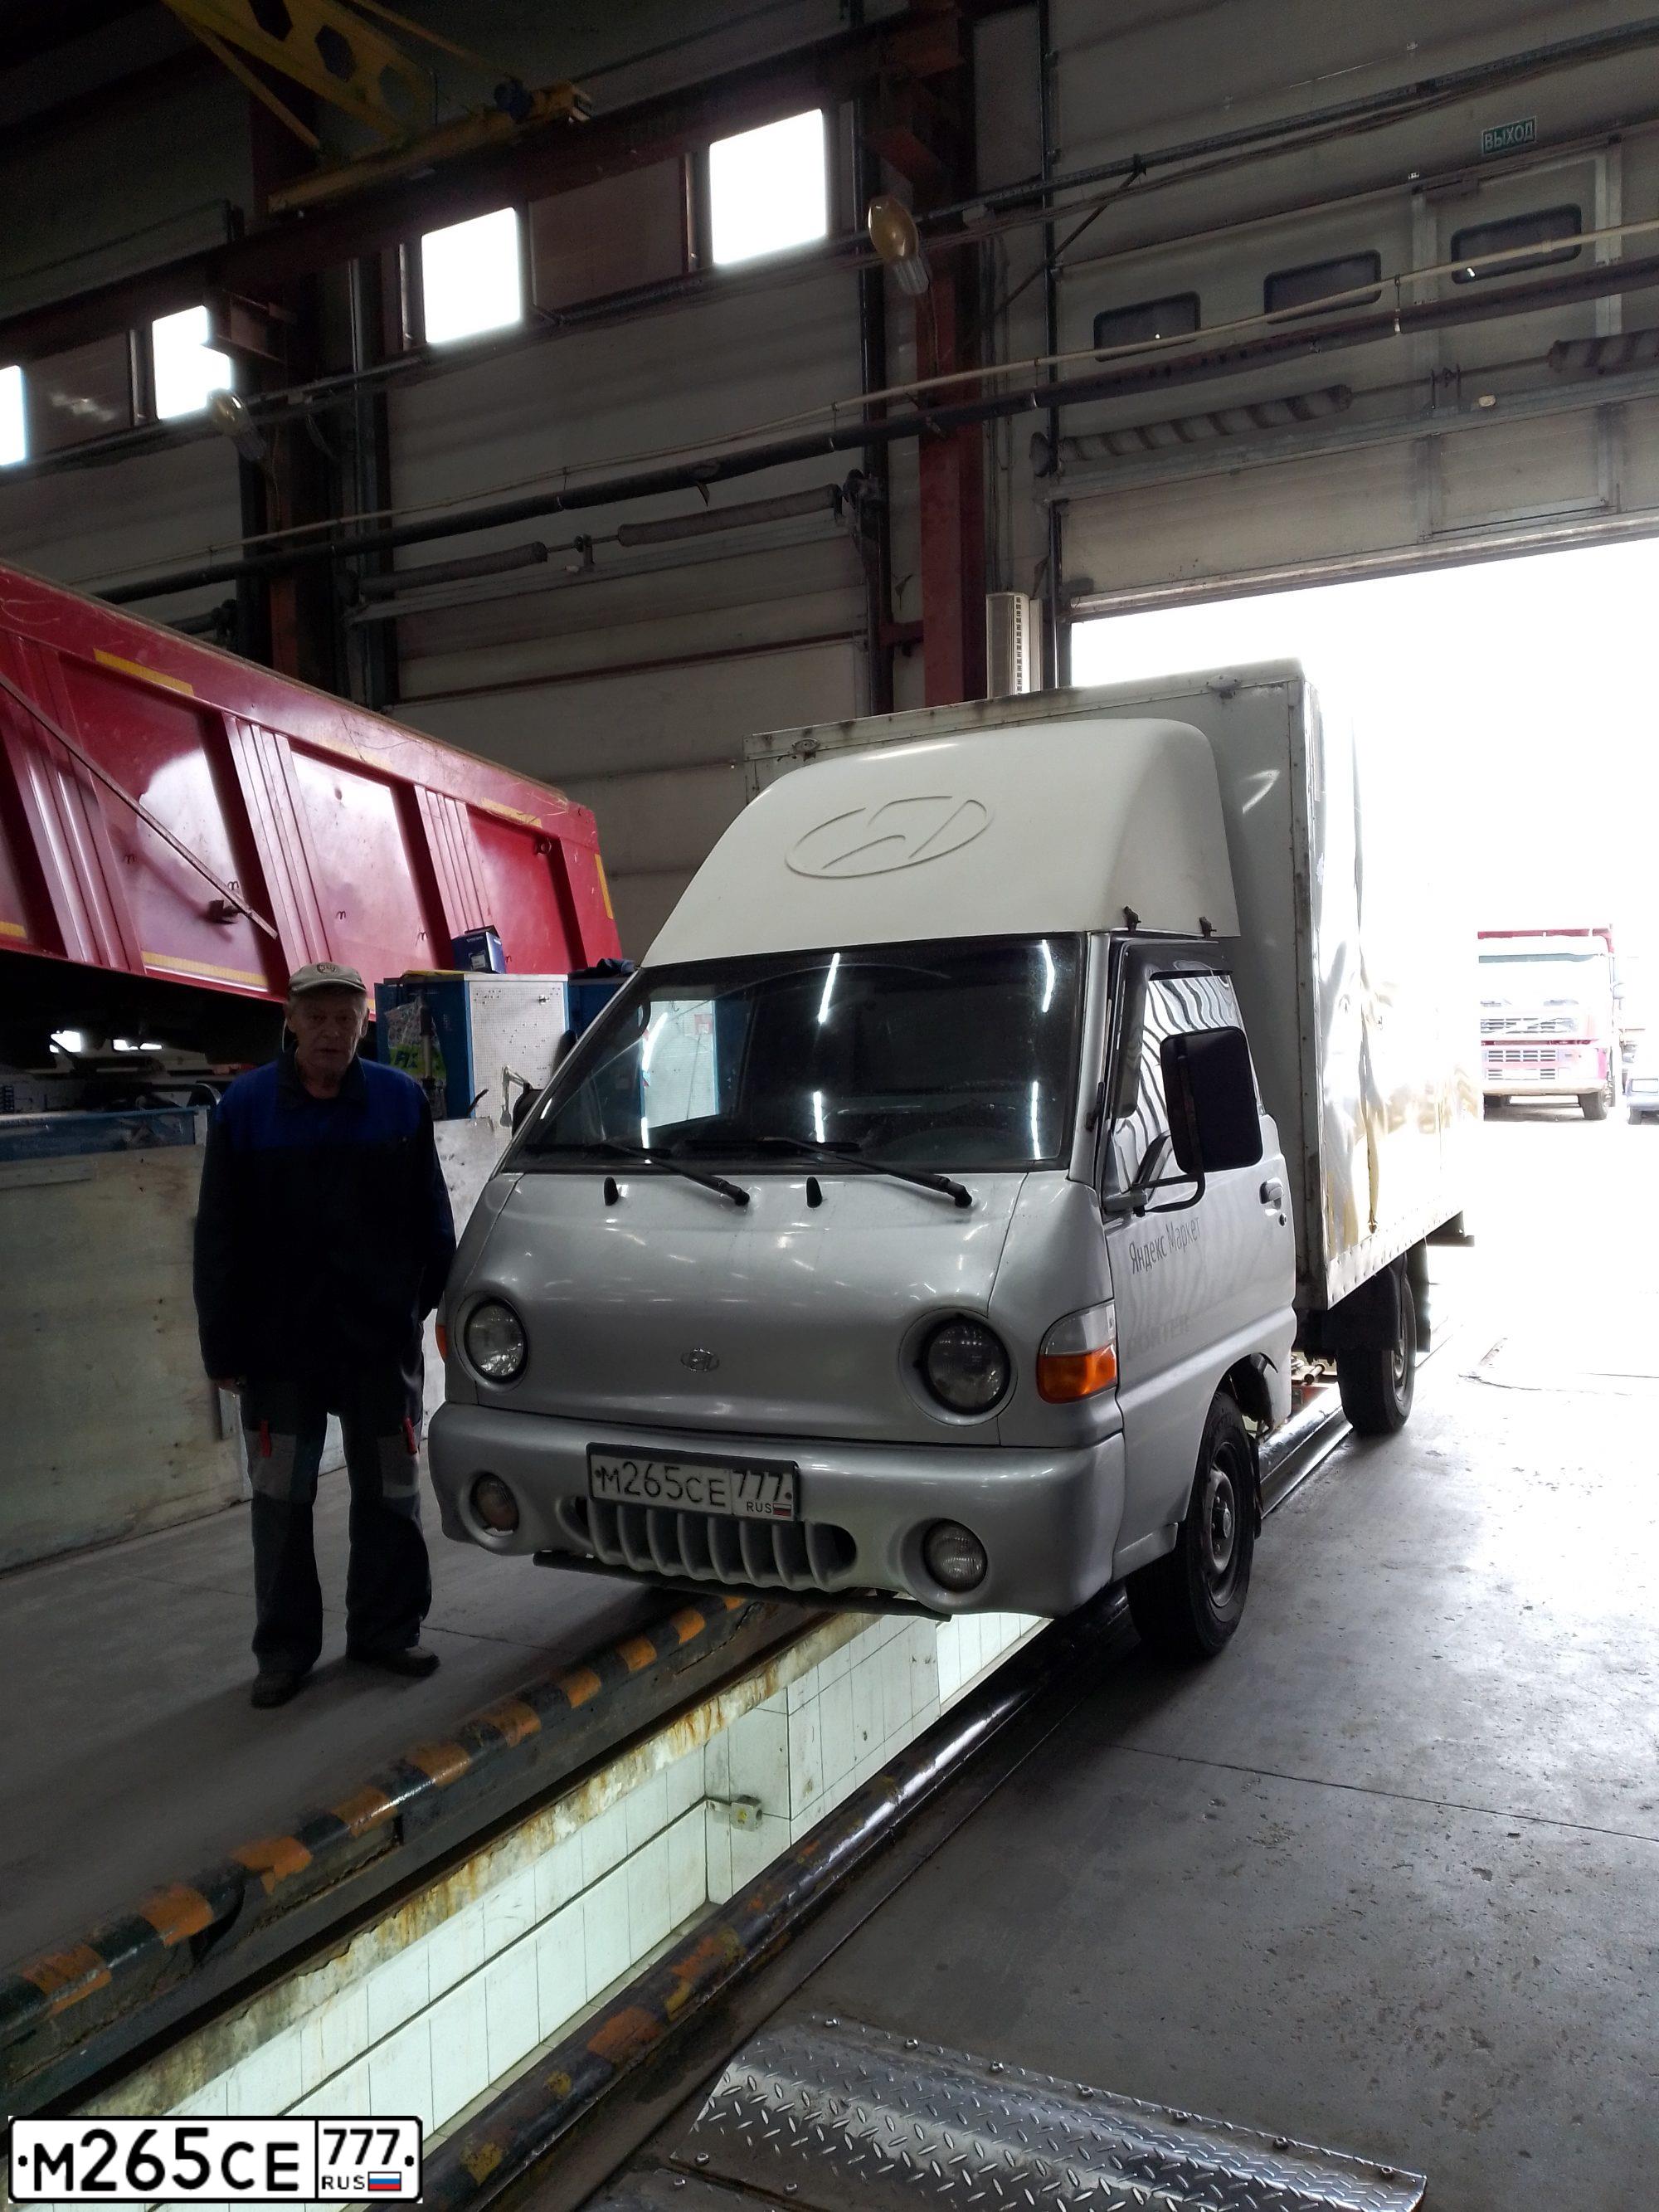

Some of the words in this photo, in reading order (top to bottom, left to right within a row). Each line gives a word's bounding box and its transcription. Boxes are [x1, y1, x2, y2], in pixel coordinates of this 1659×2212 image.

[1485, 121, 1534, 149] ВЫХОД
[1129, 1235, 1168, 1274] Яндекс
[1165, 1216, 1202, 1255] Маркет
[600, 1461, 726, 1508] М265СЕ
[732, 1470, 784, 1503] 777
[747, 1501, 772, 1513] RUS
